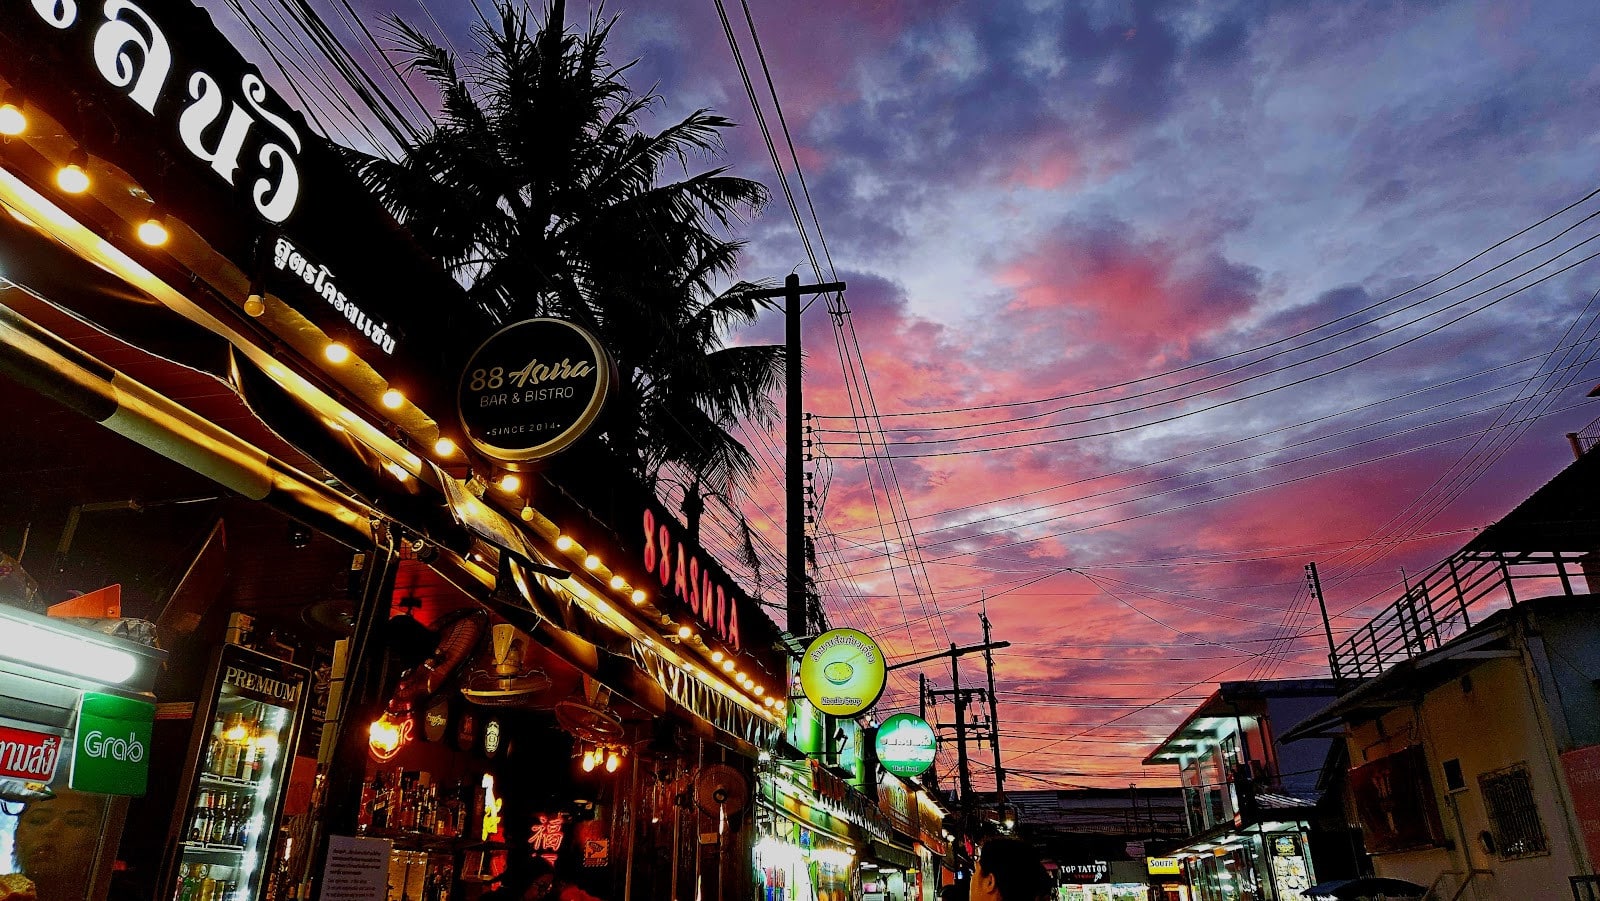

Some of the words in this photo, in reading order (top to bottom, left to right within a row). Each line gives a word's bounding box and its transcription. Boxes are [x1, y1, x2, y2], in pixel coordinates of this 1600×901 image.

[470, 366, 504, 391] 88
[508, 357, 595, 389] Asura
[480, 393, 508, 408] BAR
[511, 392, 521, 404] &
[524, 386, 574, 402] BISTRO
[528, 422, 556, 432] 2014
[223, 666, 297, 703] PREMIUM
[821, 697, 843, 706] Noodle
[843, 697, 862, 707] Soup
[83, 730, 145, 763] Grab
[528, 816, 564, 852] 福
[1061, 865, 1076, 874] TOP
[1077, 864, 1107, 873] TATTOO
